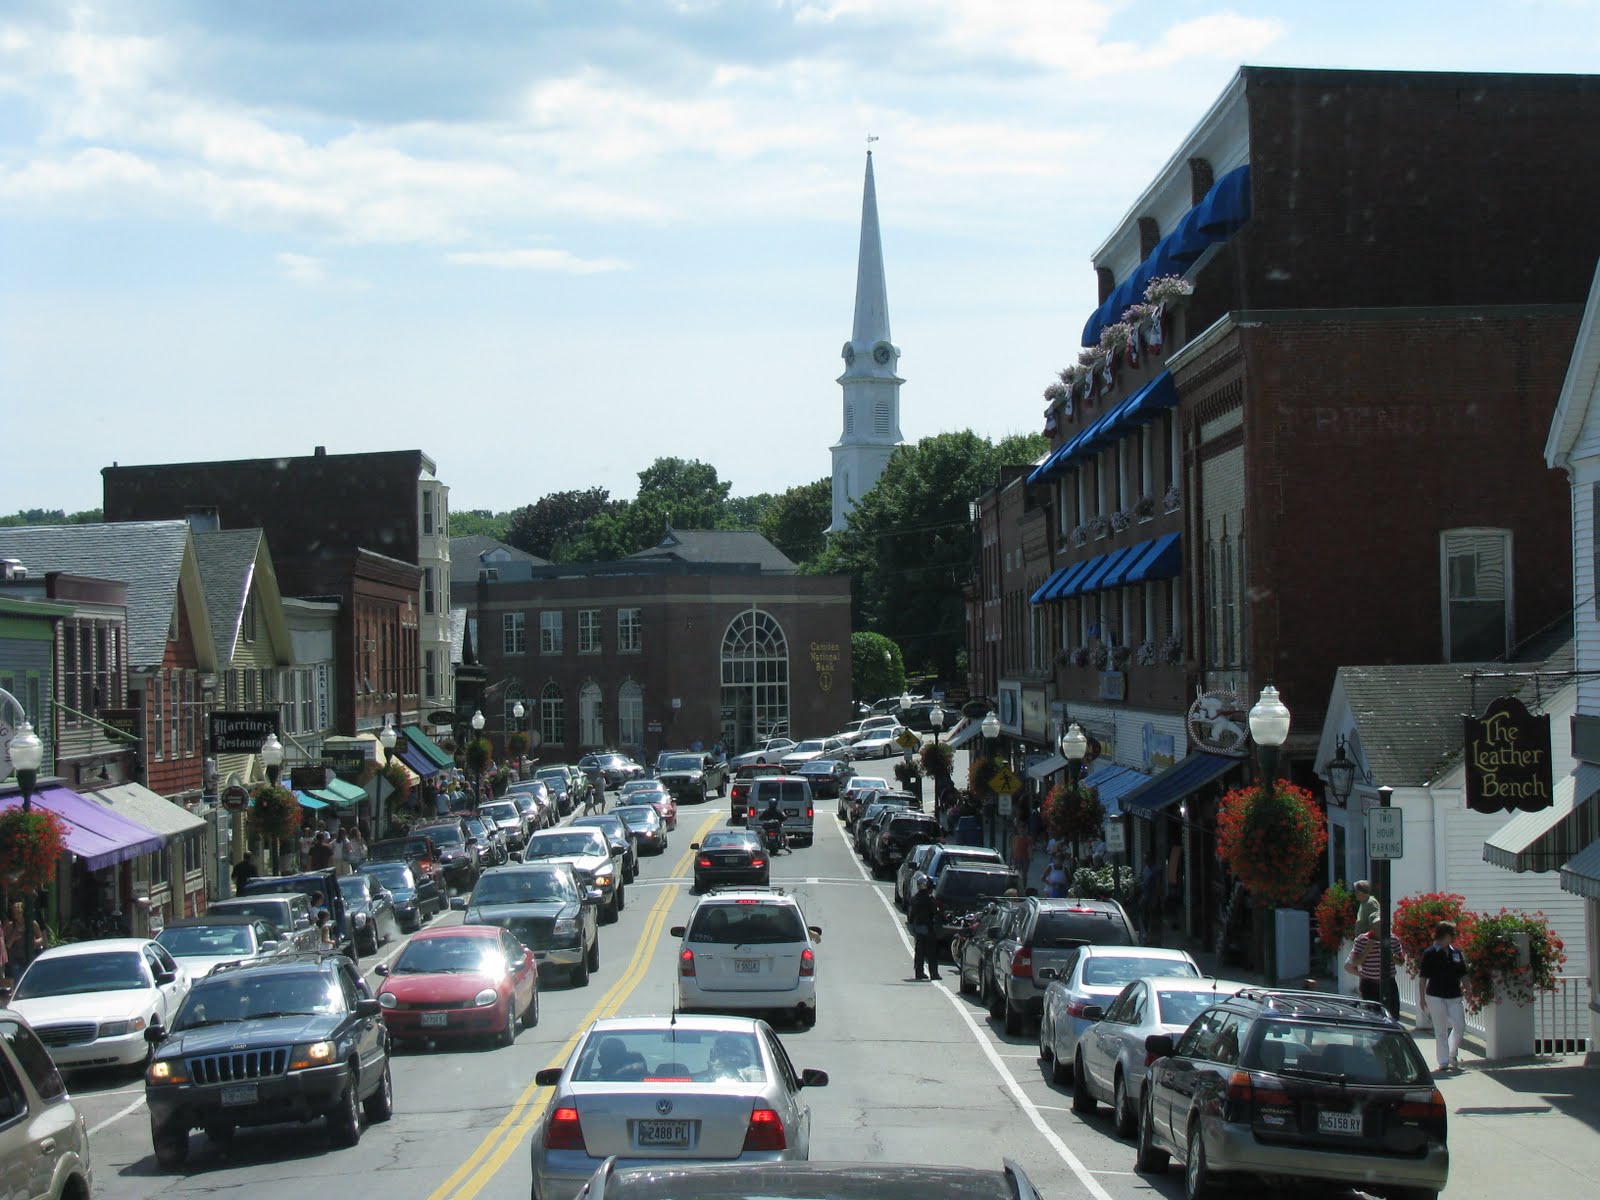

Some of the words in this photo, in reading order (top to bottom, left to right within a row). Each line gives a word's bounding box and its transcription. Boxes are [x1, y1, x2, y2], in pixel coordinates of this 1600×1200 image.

[810, 642, 839, 651] Camden
[810, 652, 840, 661] National
[816, 662, 836, 671] Bank
[1480, 711, 1519, 746] The
[1473, 739, 1545, 772] Leather
[1480, 773, 1548, 798] Bench
[1379, 813, 1392, 823] TWO
[1376, 828, 1394, 838] HOUR
[1371, 842, 1400, 853] PARKING
[1328, 1117, 1349, 1129] 5158
[1350, 1118, 1361, 1130] RY
[675, 1126, 687, 1140] PL
